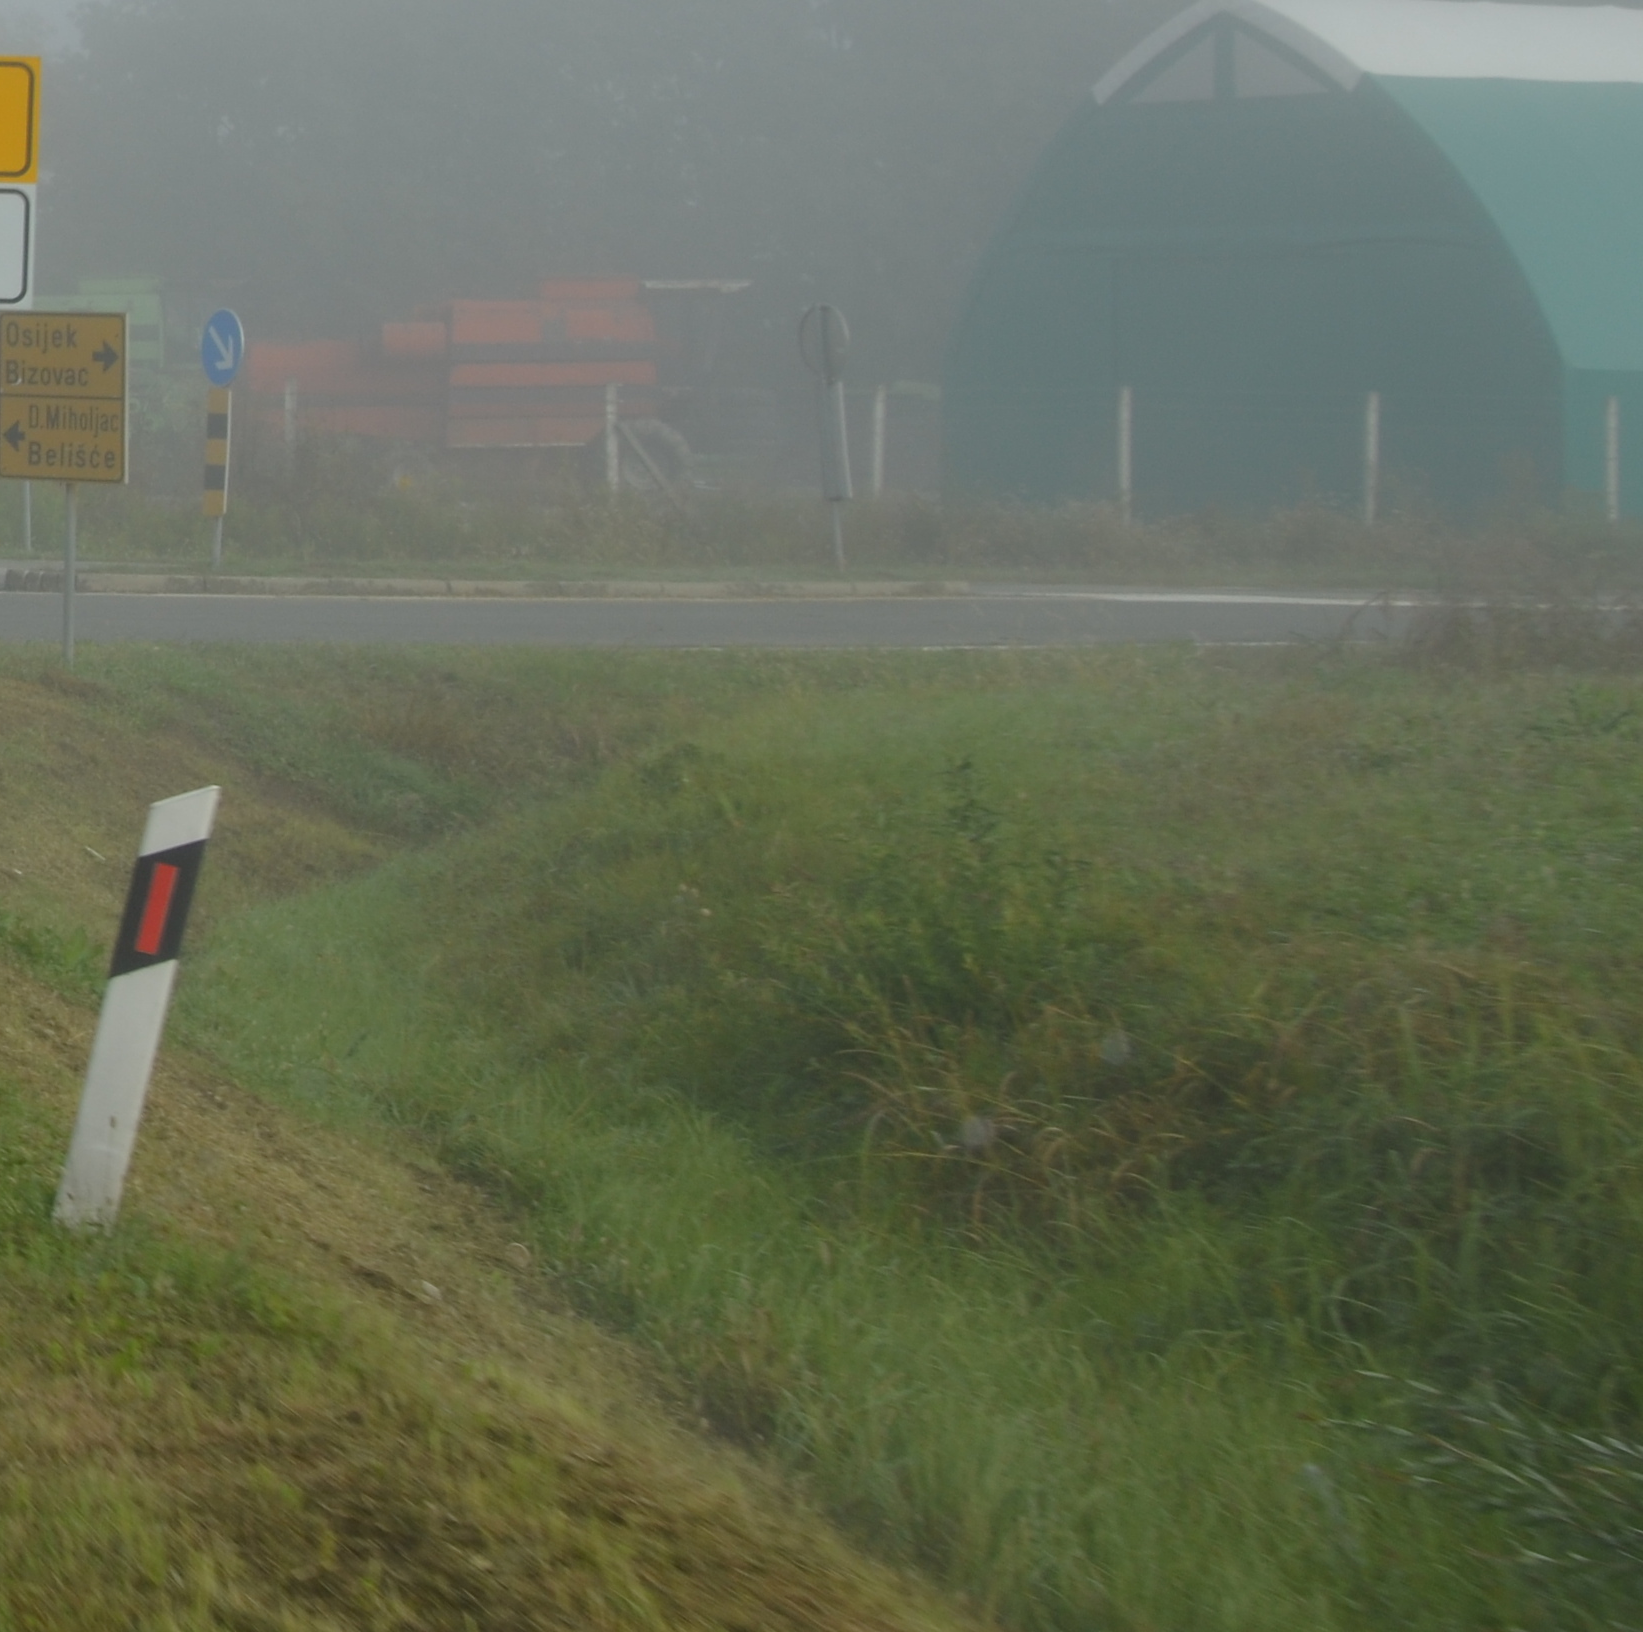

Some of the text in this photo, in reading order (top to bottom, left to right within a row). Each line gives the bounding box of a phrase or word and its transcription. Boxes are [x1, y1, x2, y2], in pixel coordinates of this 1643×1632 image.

[5, 321, 78, 354] Osijek
[5, 359, 89, 387] Bizovac
[27, 441, 116, 470] Belišće
